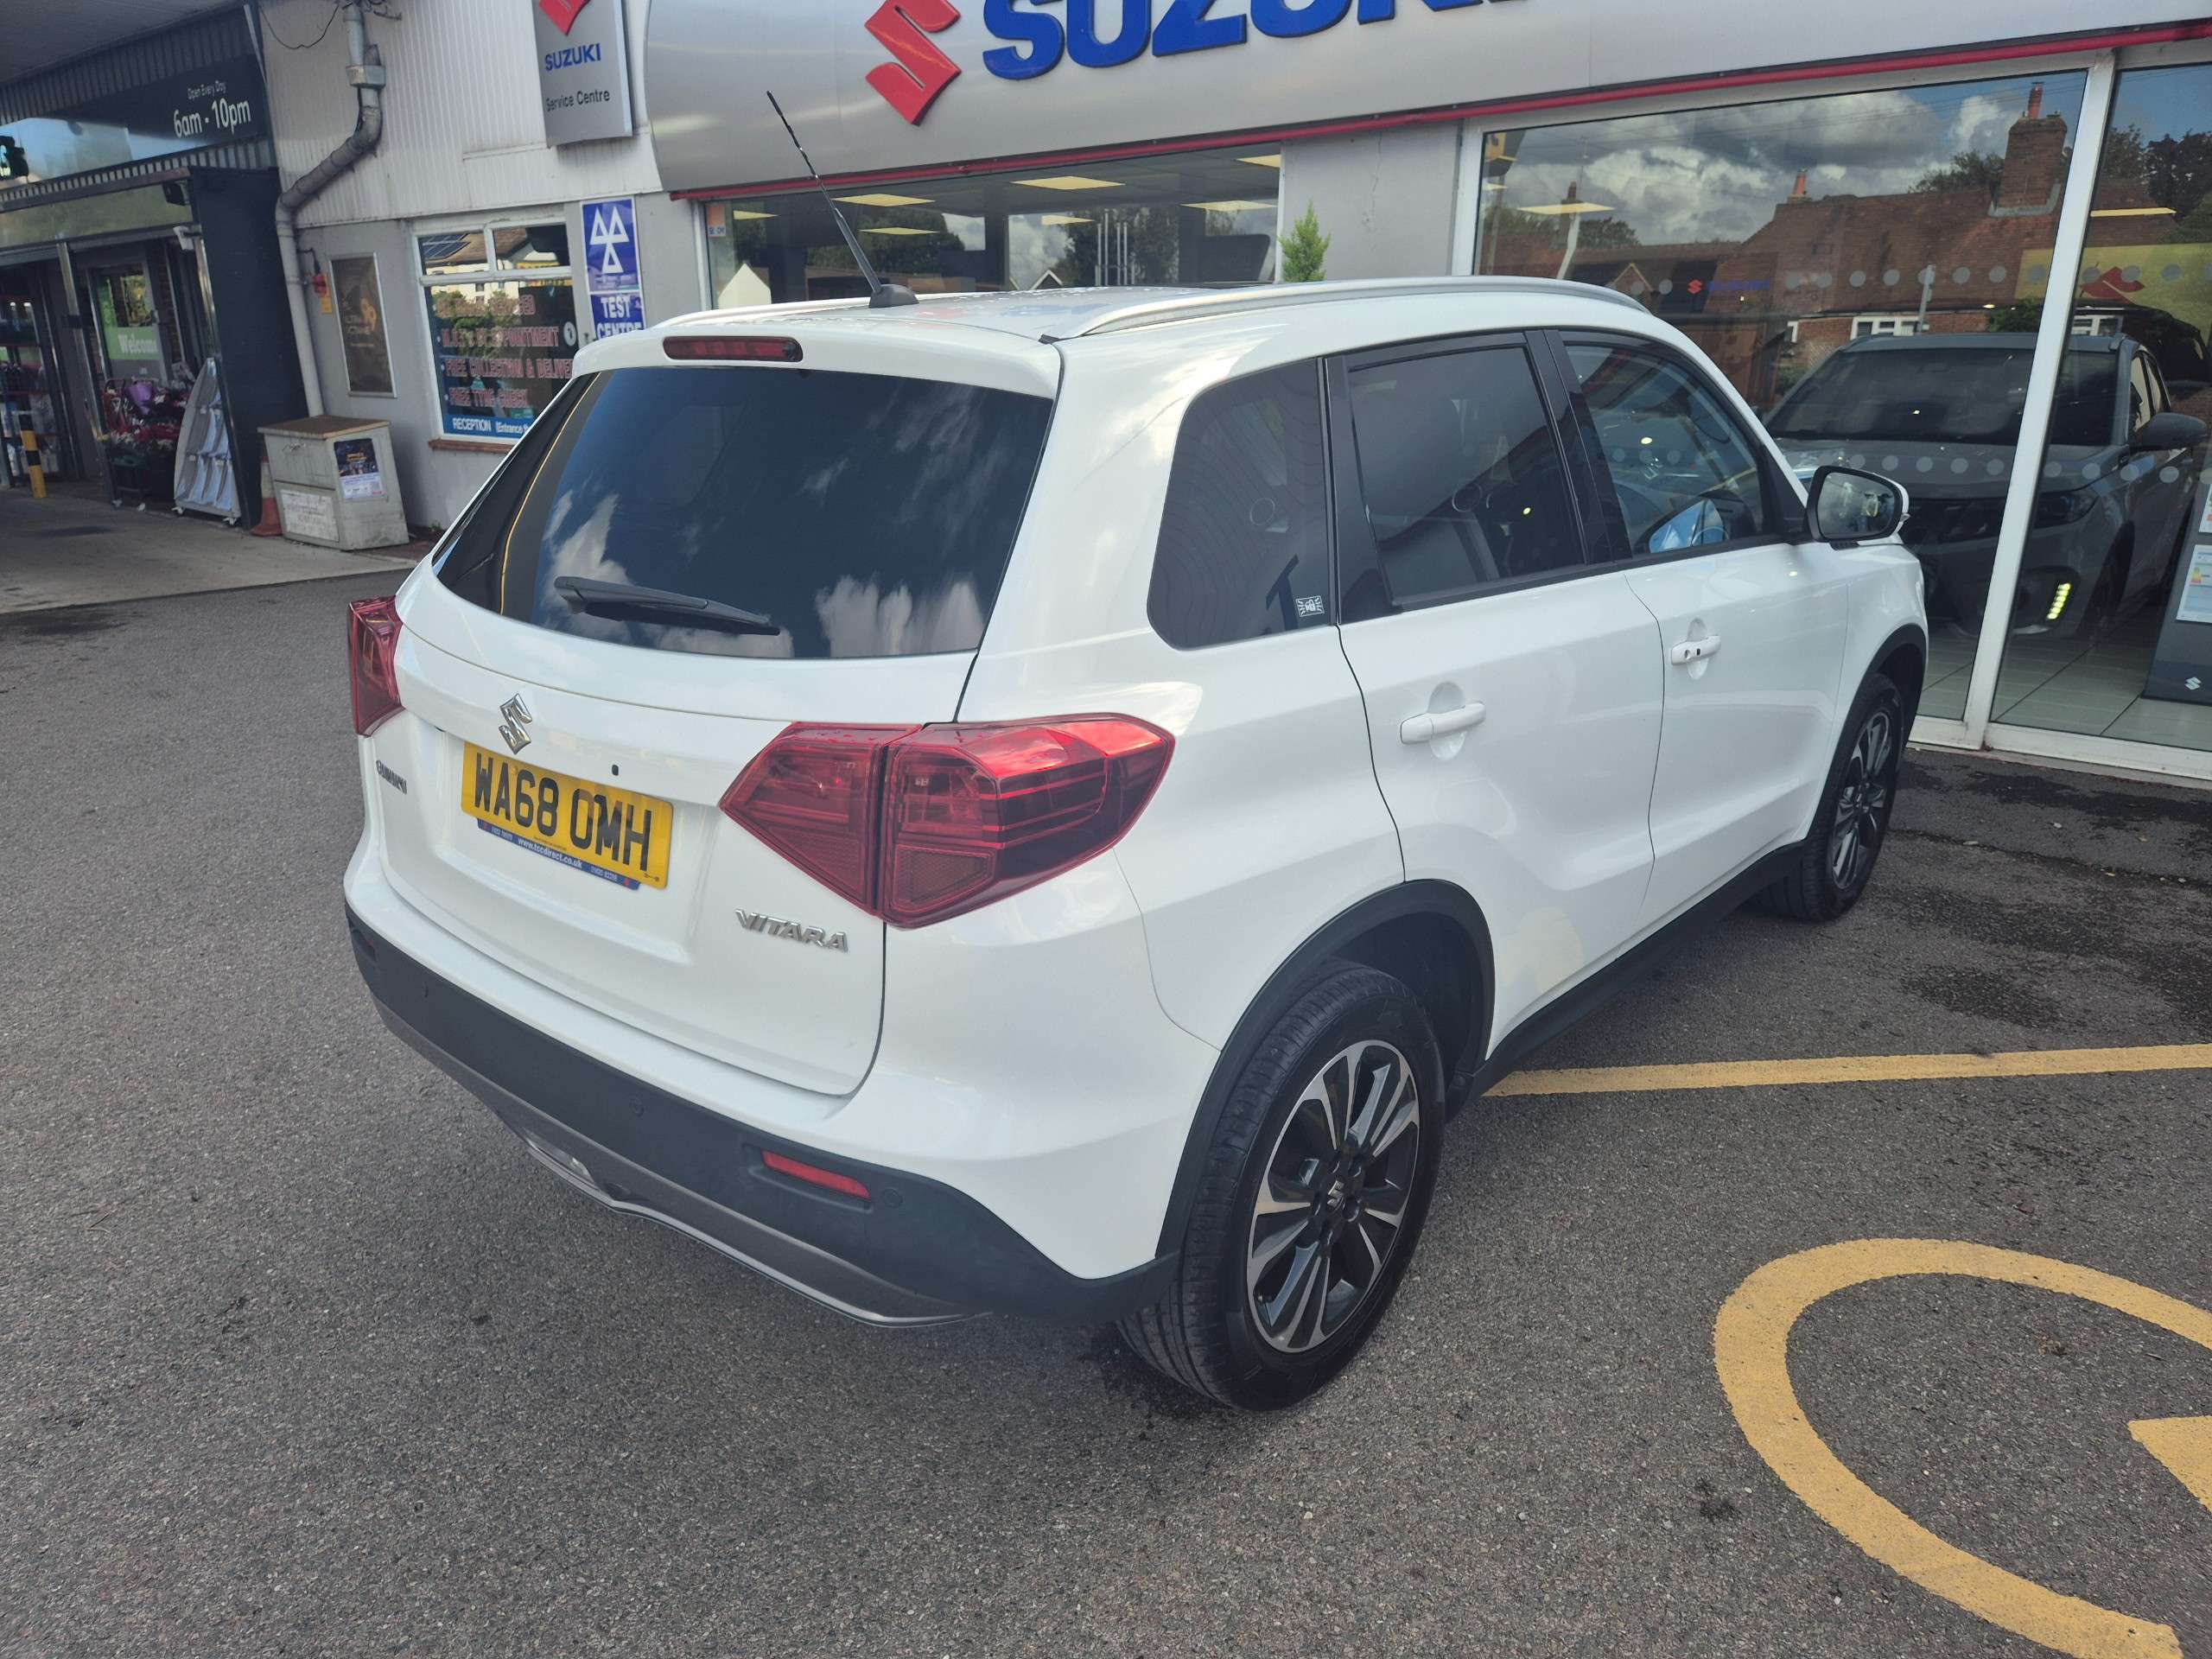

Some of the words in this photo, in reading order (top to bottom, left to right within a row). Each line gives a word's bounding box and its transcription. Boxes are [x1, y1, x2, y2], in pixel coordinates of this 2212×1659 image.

[983, 0, 1525, 80] SUZ
[544, 43, 601, 71] SUZUKI
[546, 95, 575, 111] Service
[576, 90, 610, 105] Centre
[174, 109, 203, 137] 6am
[212, 98, 251, 135] 10pm
[601, 296, 631, 318] TEST
[452, 417, 492, 432] RECEPTION
[474, 753, 559, 836] WA68
[570, 788, 652, 871] OMH
[518, 837, 583, 869] www.tccdirect.co.uk
[735, 908, 849, 953] VITARA
